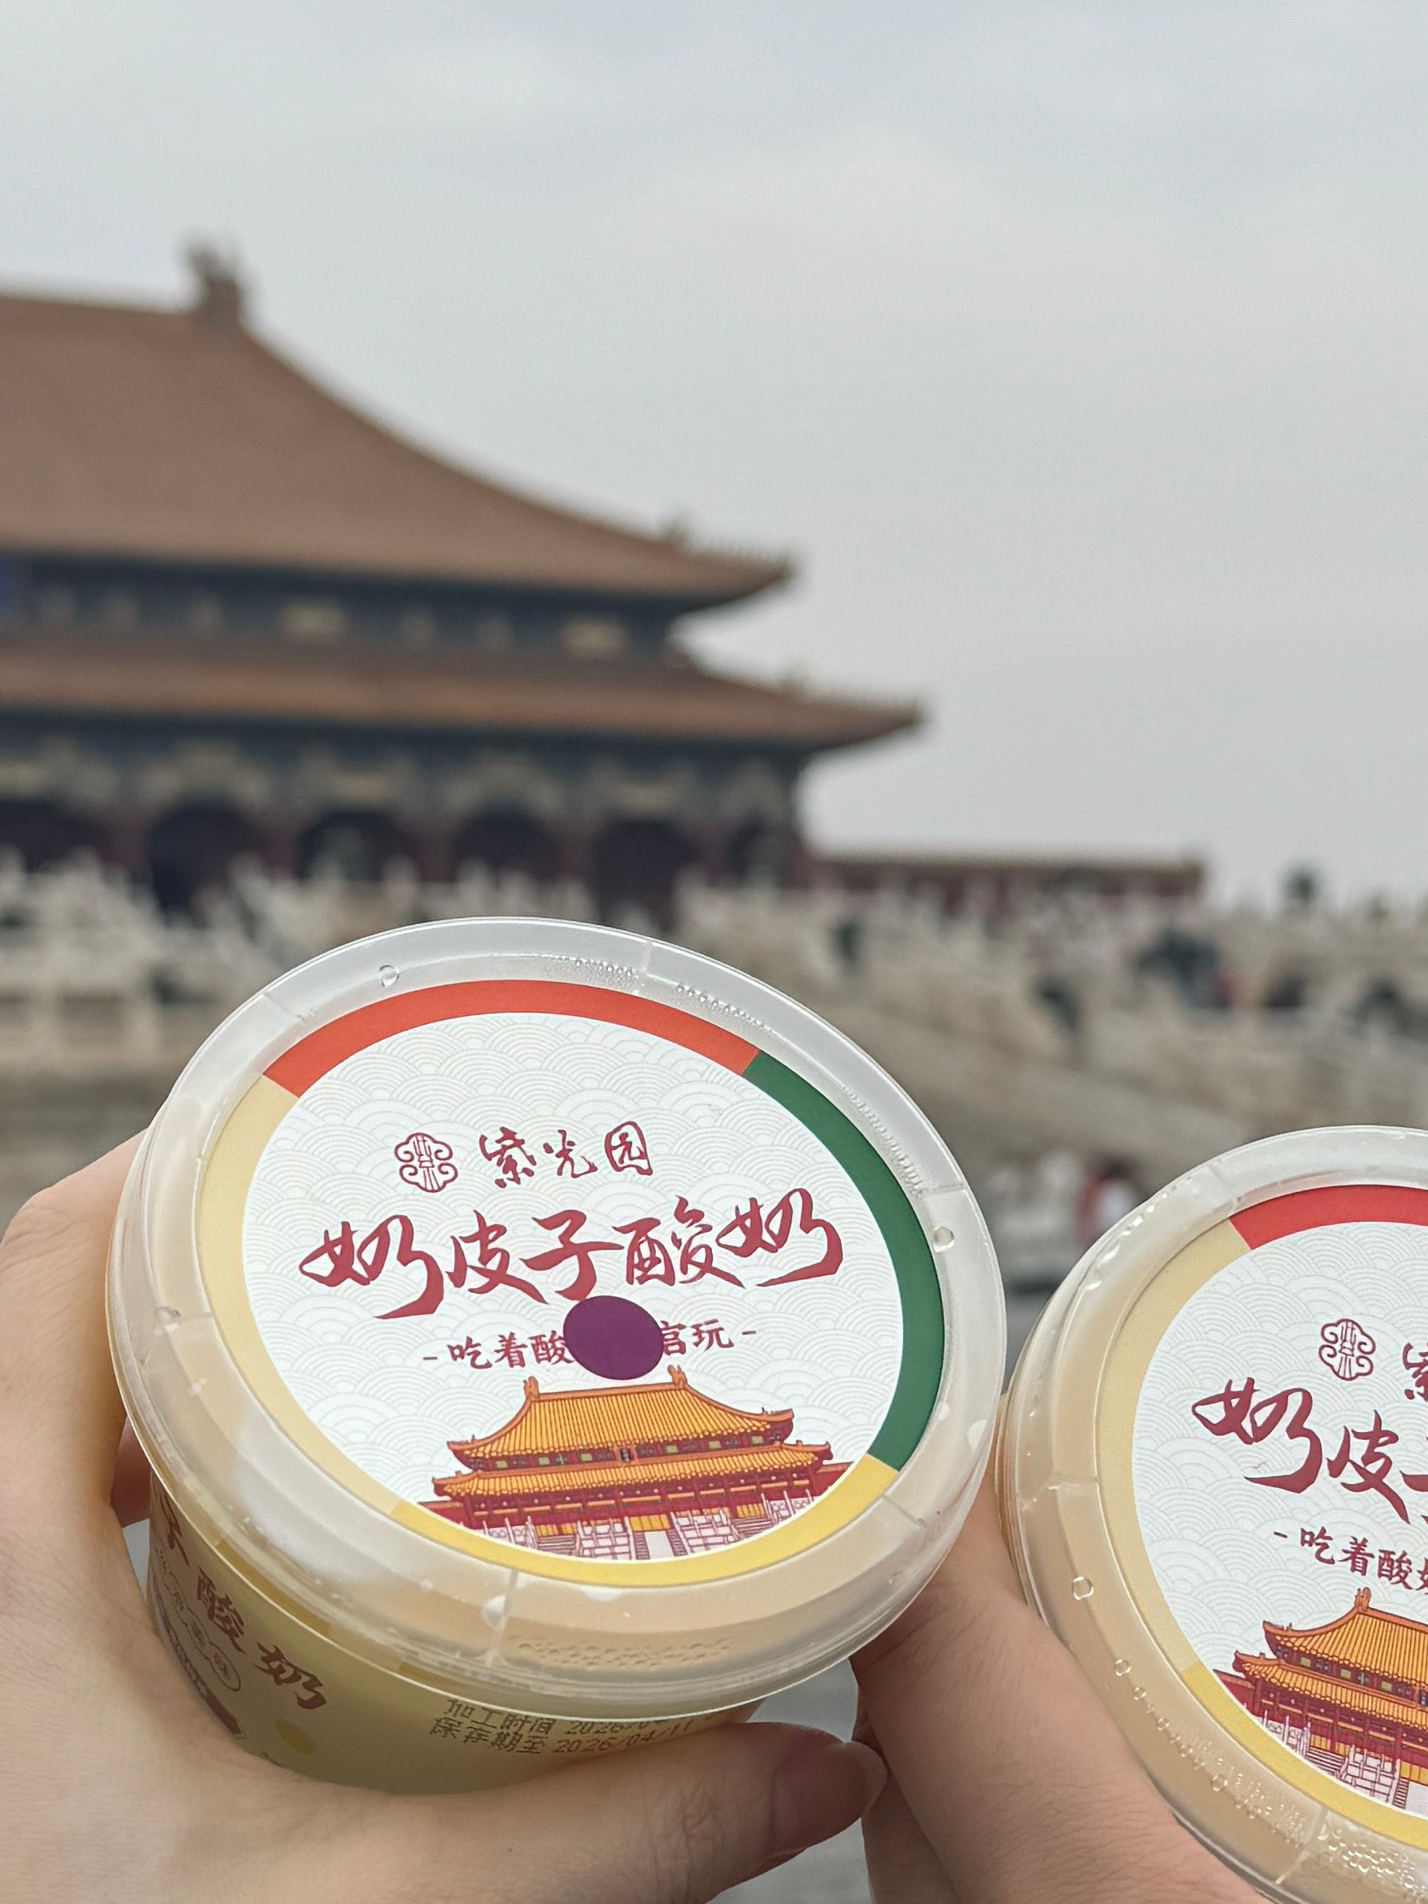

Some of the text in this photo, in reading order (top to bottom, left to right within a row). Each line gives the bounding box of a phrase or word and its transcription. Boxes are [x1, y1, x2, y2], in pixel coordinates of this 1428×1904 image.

[478, 1121, 652, 1188] 紫光园
[298, 1188, 844, 1320] 奶皮子酸奶
